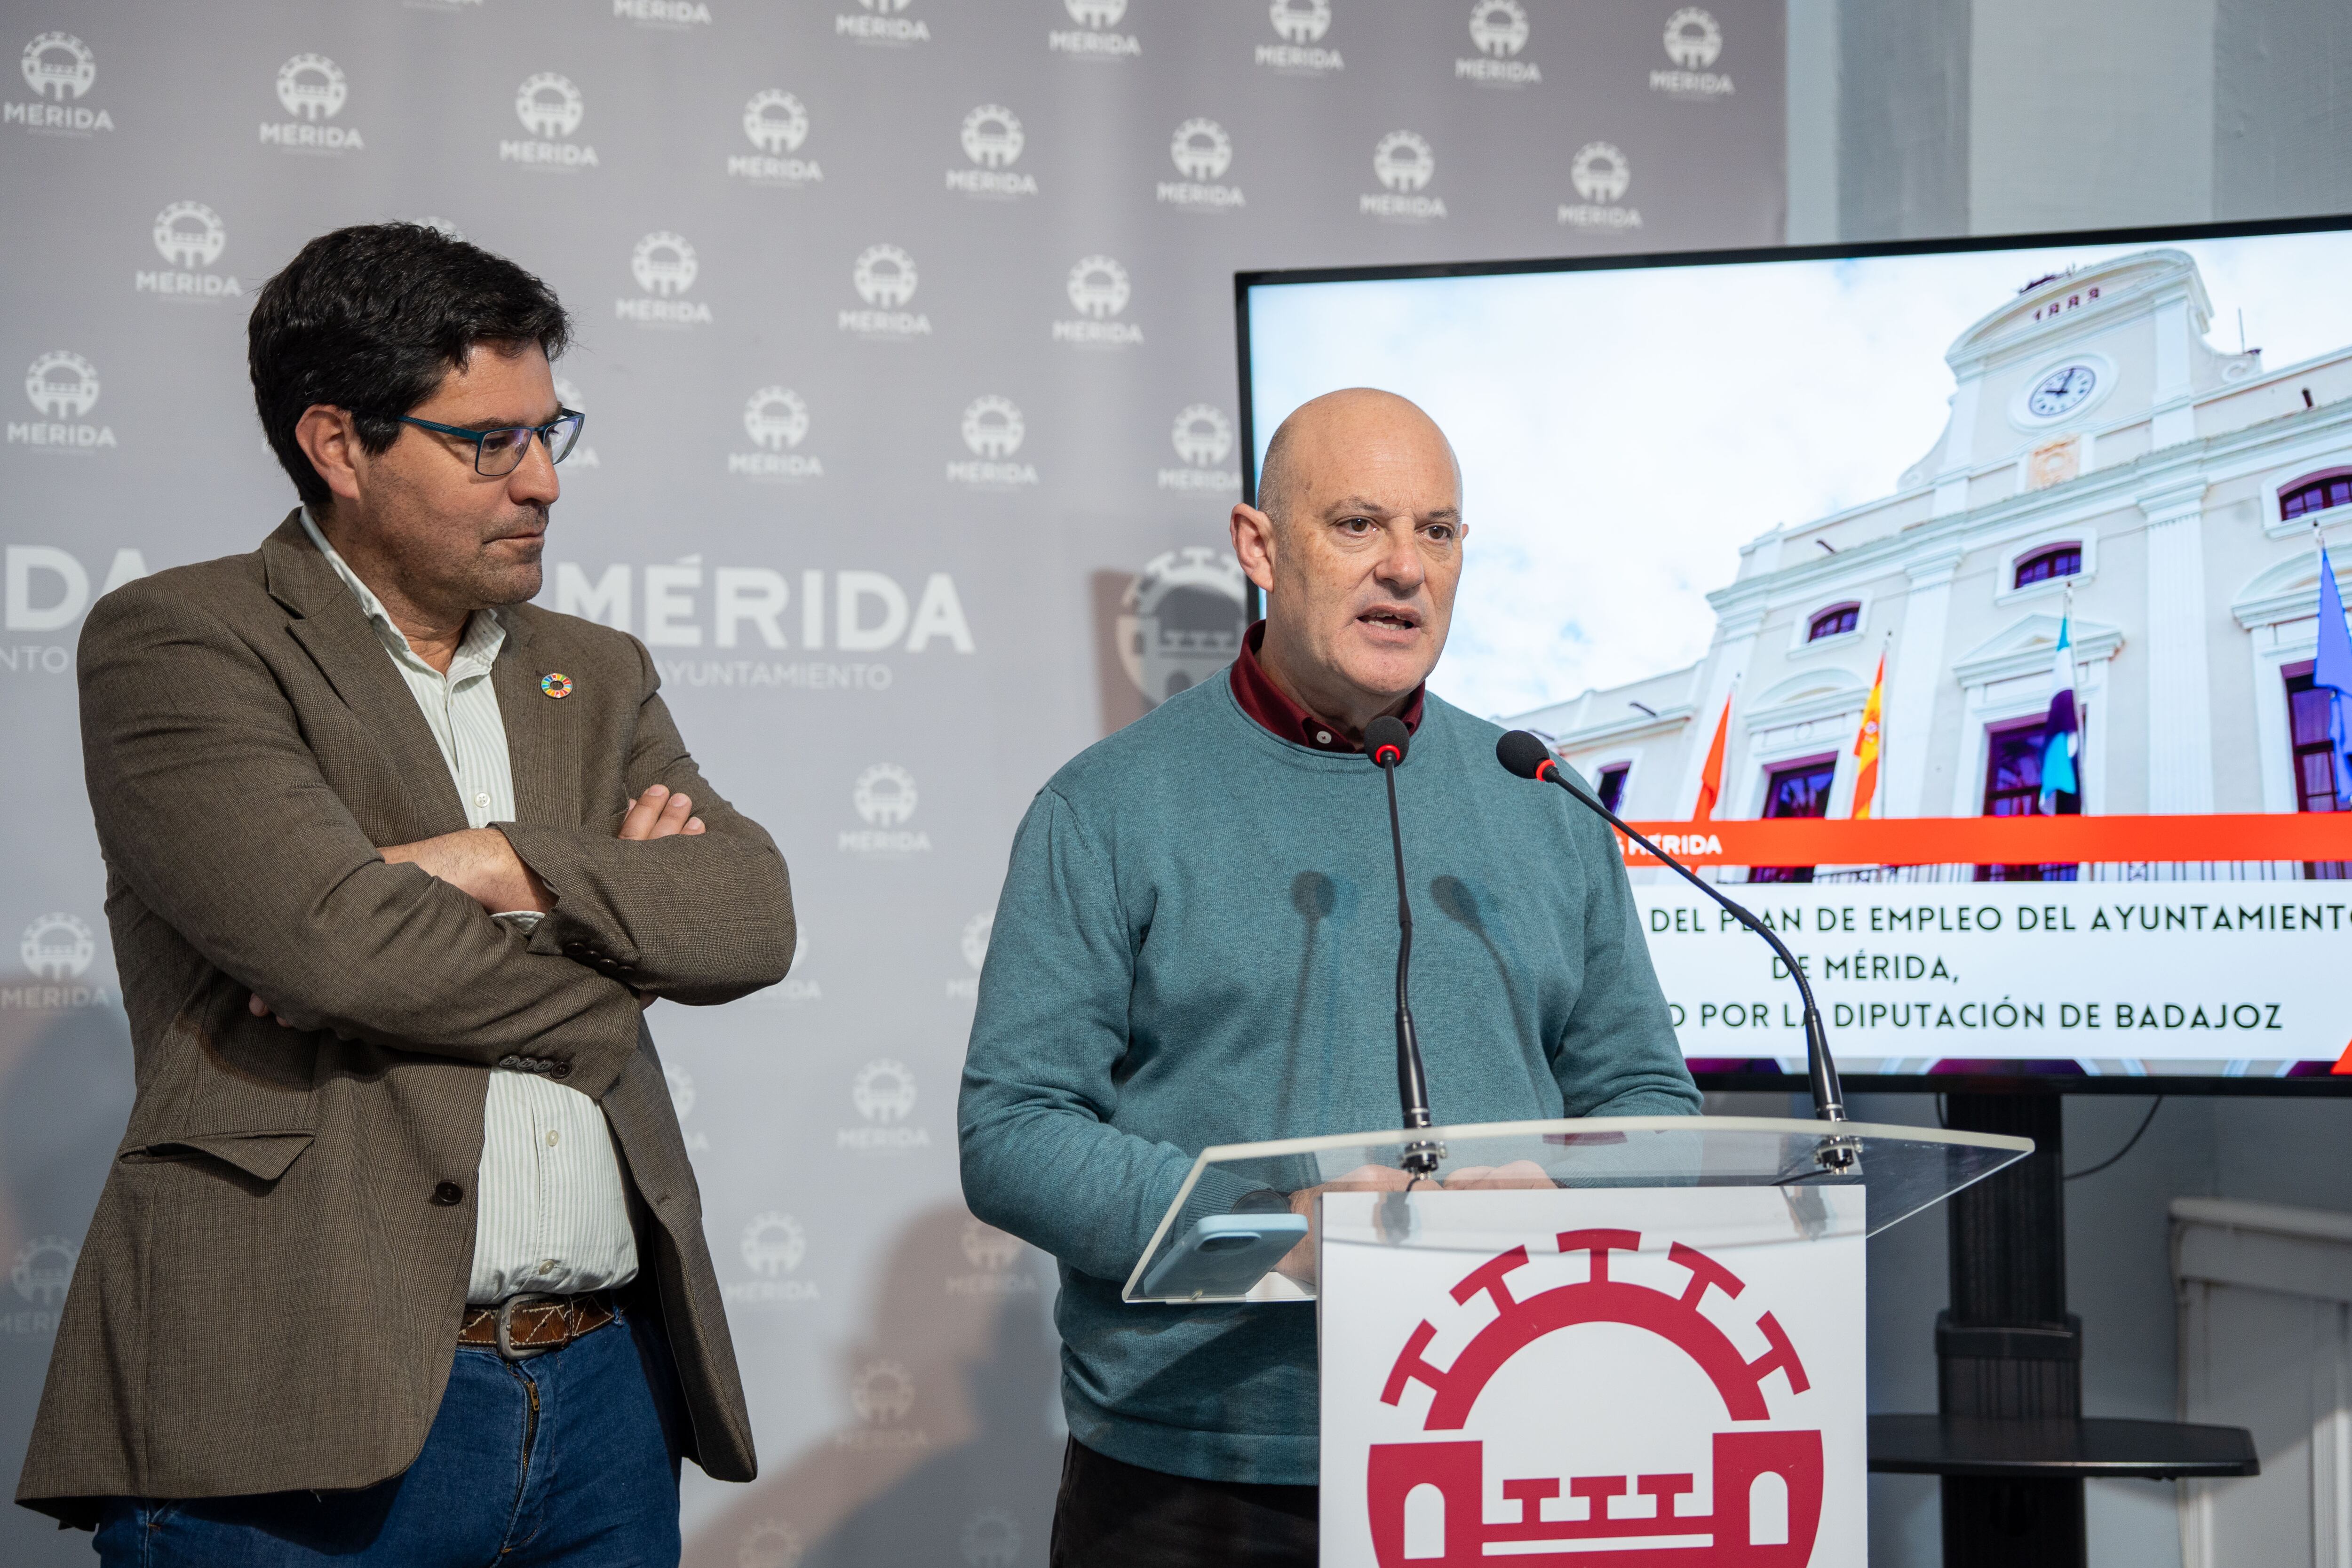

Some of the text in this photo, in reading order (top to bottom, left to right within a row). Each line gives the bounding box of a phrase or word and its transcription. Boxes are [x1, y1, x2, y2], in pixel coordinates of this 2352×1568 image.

[556, 553, 976, 654] MÉRIDA
[1652, 908, 1705, 932] DEL
[1818, 908, 1855, 931] DE
[1871, 907, 2001, 931] EMPLEO
[2018, 907, 2076, 930] DEL
[2091, 905, 2352, 931] AYUNTAMIENT
[1773, 950, 1957, 983] DE MÉRIDA,
[1701, 1004, 1768, 1027] POR
[1784, 1004, 1807, 1027] L
[1835, 996, 2043, 1027] DIPUTACIÓN
[2061, 1003, 2100, 1027] DE
[2116, 1003, 2282, 1029] BADAJOZ
